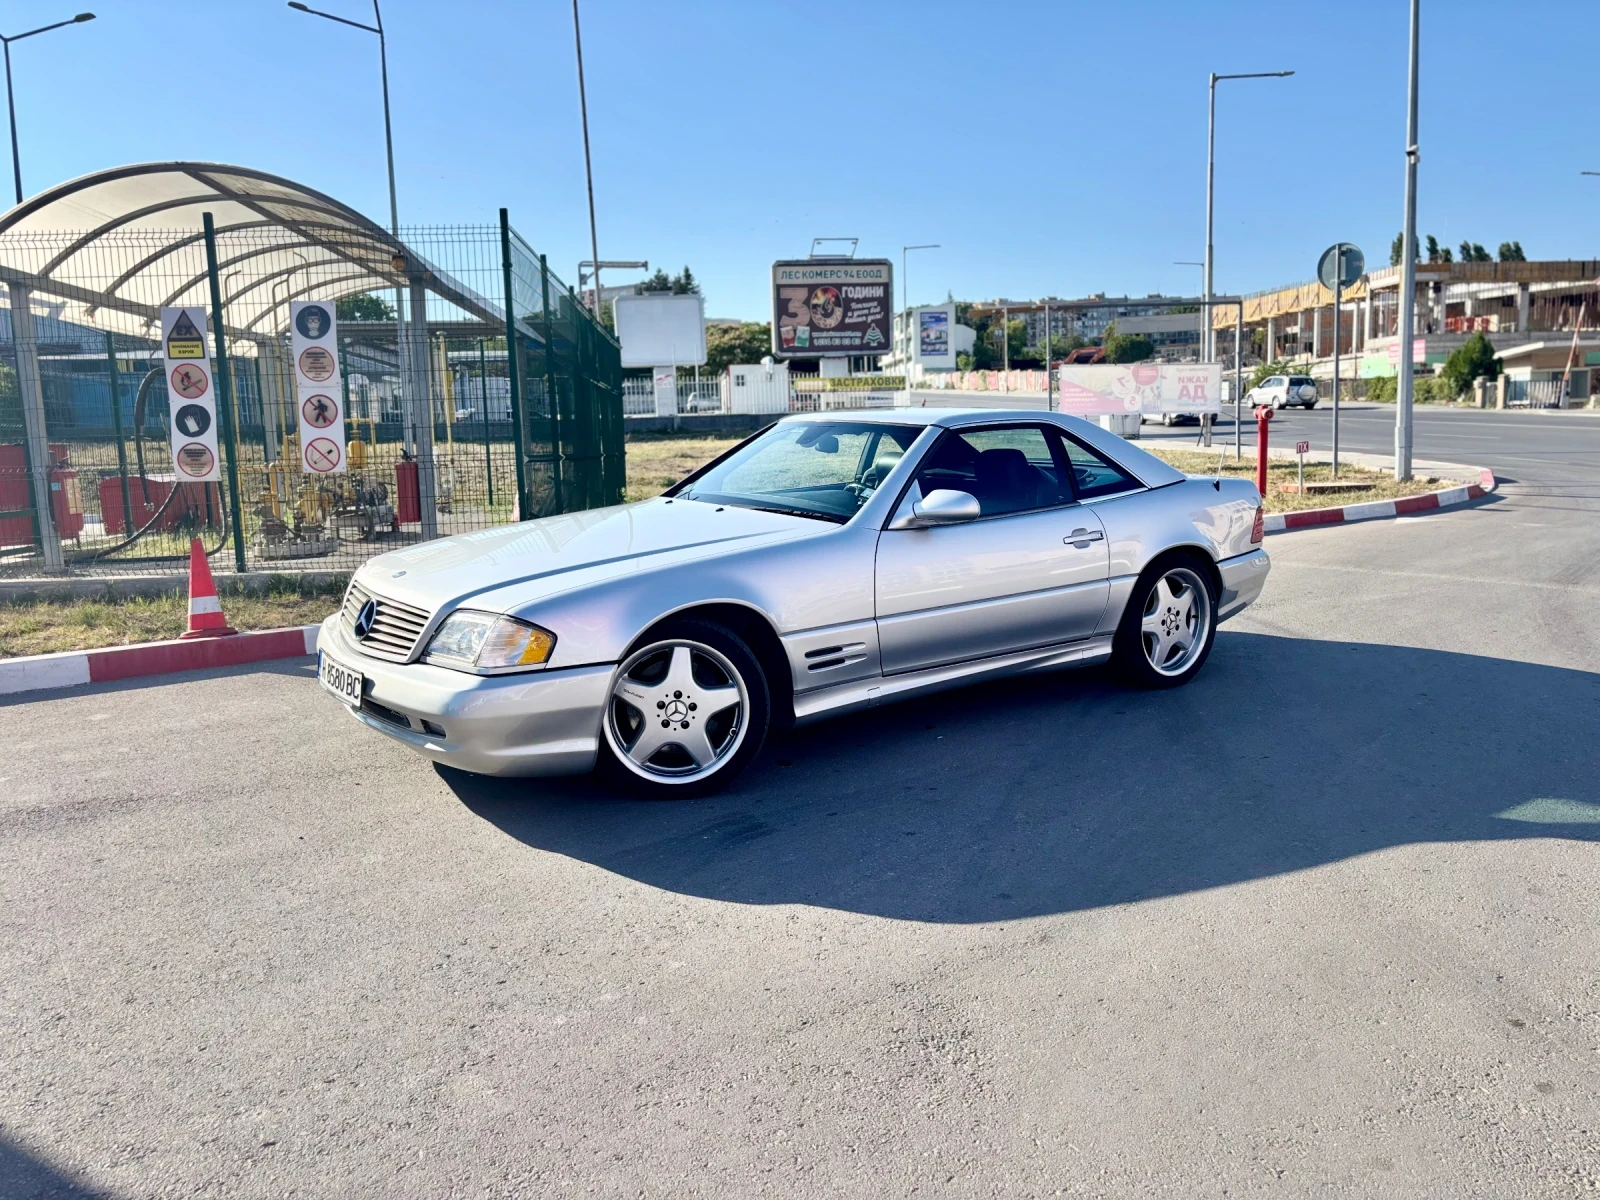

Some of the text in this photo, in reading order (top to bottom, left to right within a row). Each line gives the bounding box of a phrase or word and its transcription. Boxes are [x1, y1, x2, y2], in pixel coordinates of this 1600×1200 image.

[781, 269, 882, 279] ЛЕС КОМЕРС 94 ЕООД
[842, 286, 884, 298] ГОДИНИ
[830, 376, 906, 387] ЗАСТРАХОВКИ
[1298, 441, 1308, 453] ПХ
[346, 673, 360, 699] BC
